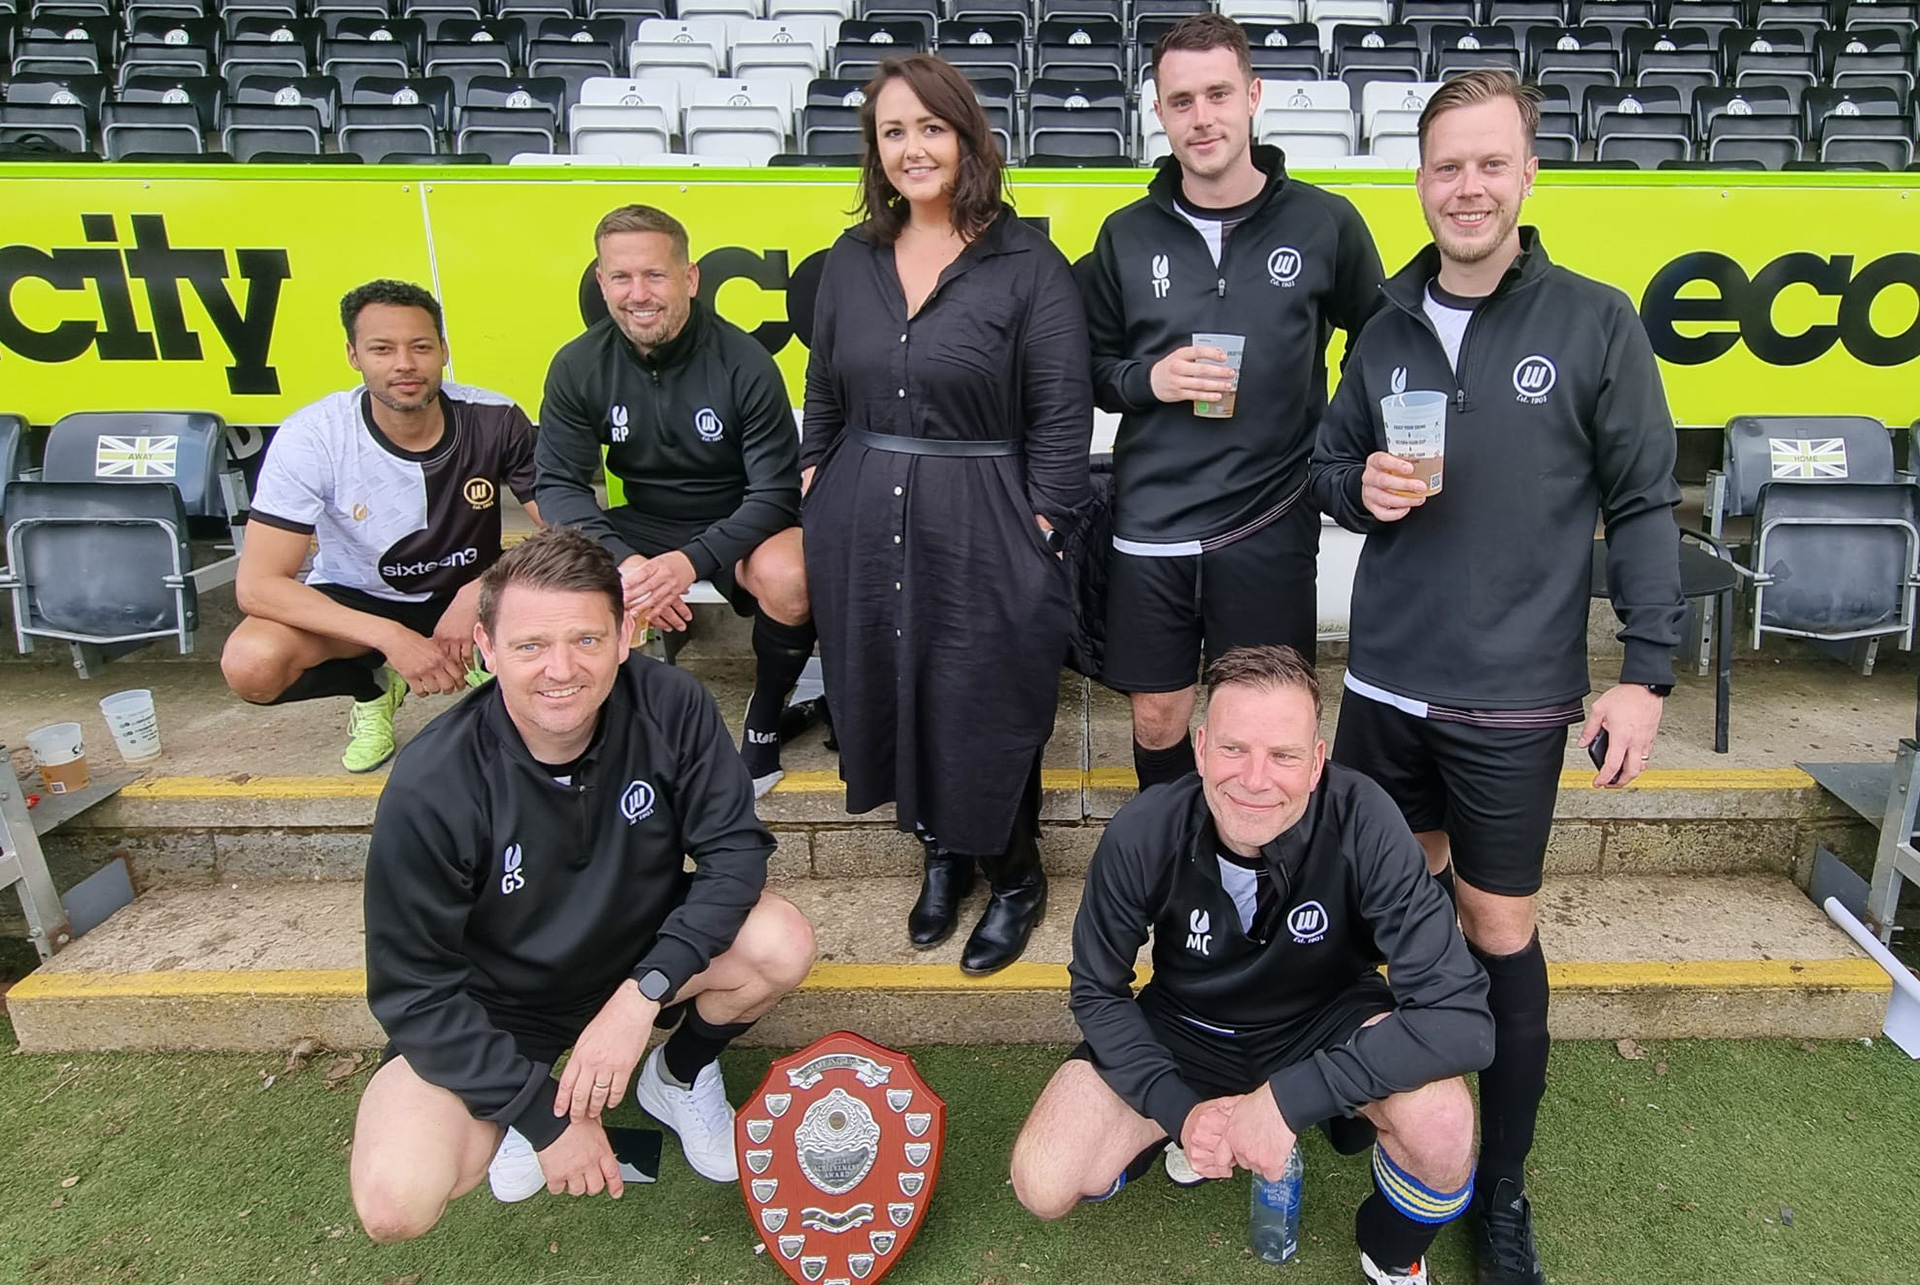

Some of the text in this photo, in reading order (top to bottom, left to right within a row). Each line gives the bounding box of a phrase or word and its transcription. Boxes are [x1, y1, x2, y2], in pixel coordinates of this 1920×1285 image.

[1151, 277, 1171, 299] TP
[0, 213, 292, 396] city
[1640, 250, 1920, 367] eco
[611, 425, 630, 443] RP
[128, 453, 153, 461] AWAY
[1793, 454, 1819, 463] HOME
[381, 547, 478, 577] sixteen3
[501, 867, 525, 895] GS
[1185, 933, 1213, 956] MC
